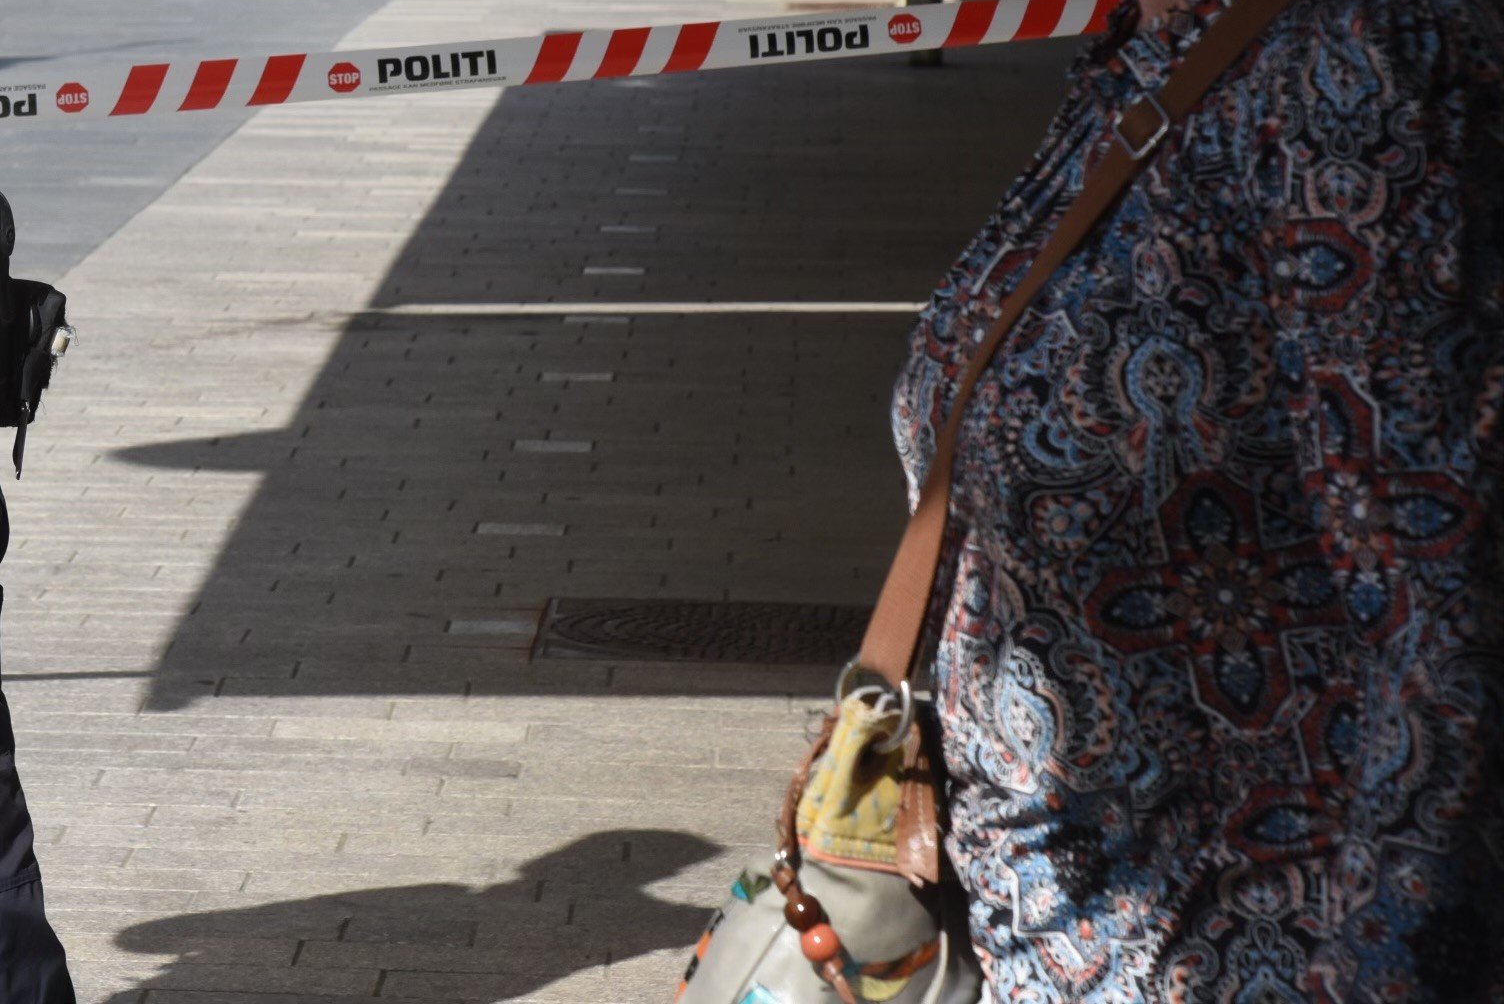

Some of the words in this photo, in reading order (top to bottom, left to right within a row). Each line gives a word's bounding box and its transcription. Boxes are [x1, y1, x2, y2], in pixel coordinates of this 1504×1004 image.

[890, 22, 920, 35] STOP
[749, 24, 869, 59] POLITI
[377, 50, 497, 84] POLITI
[329, 72, 359, 85] STOP
[57, 92, 87, 104] STOP
